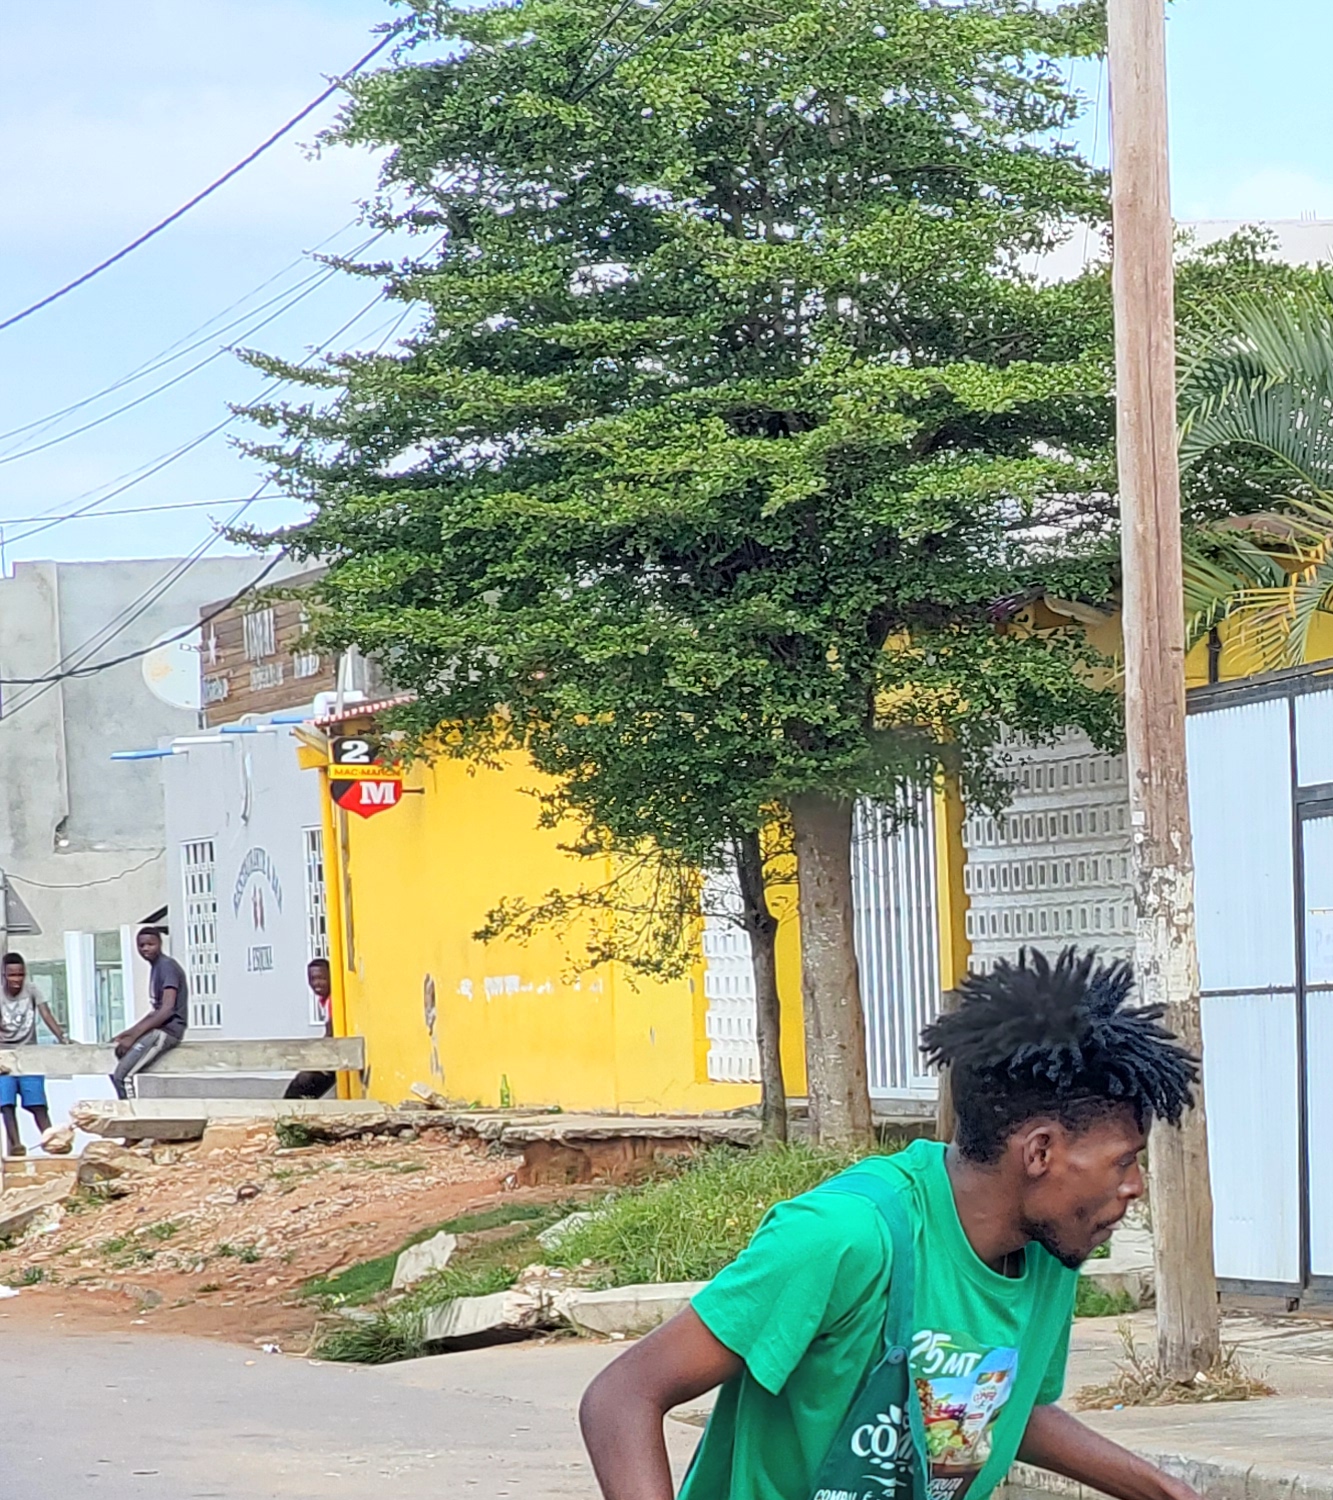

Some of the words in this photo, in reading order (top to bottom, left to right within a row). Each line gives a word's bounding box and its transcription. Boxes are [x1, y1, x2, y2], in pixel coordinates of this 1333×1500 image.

[340, 740, 370, 763] 2
[359, 781, 396, 805] M
[909, 1330, 952, 1374] 25
[941, 1352, 982, 1377] MT
